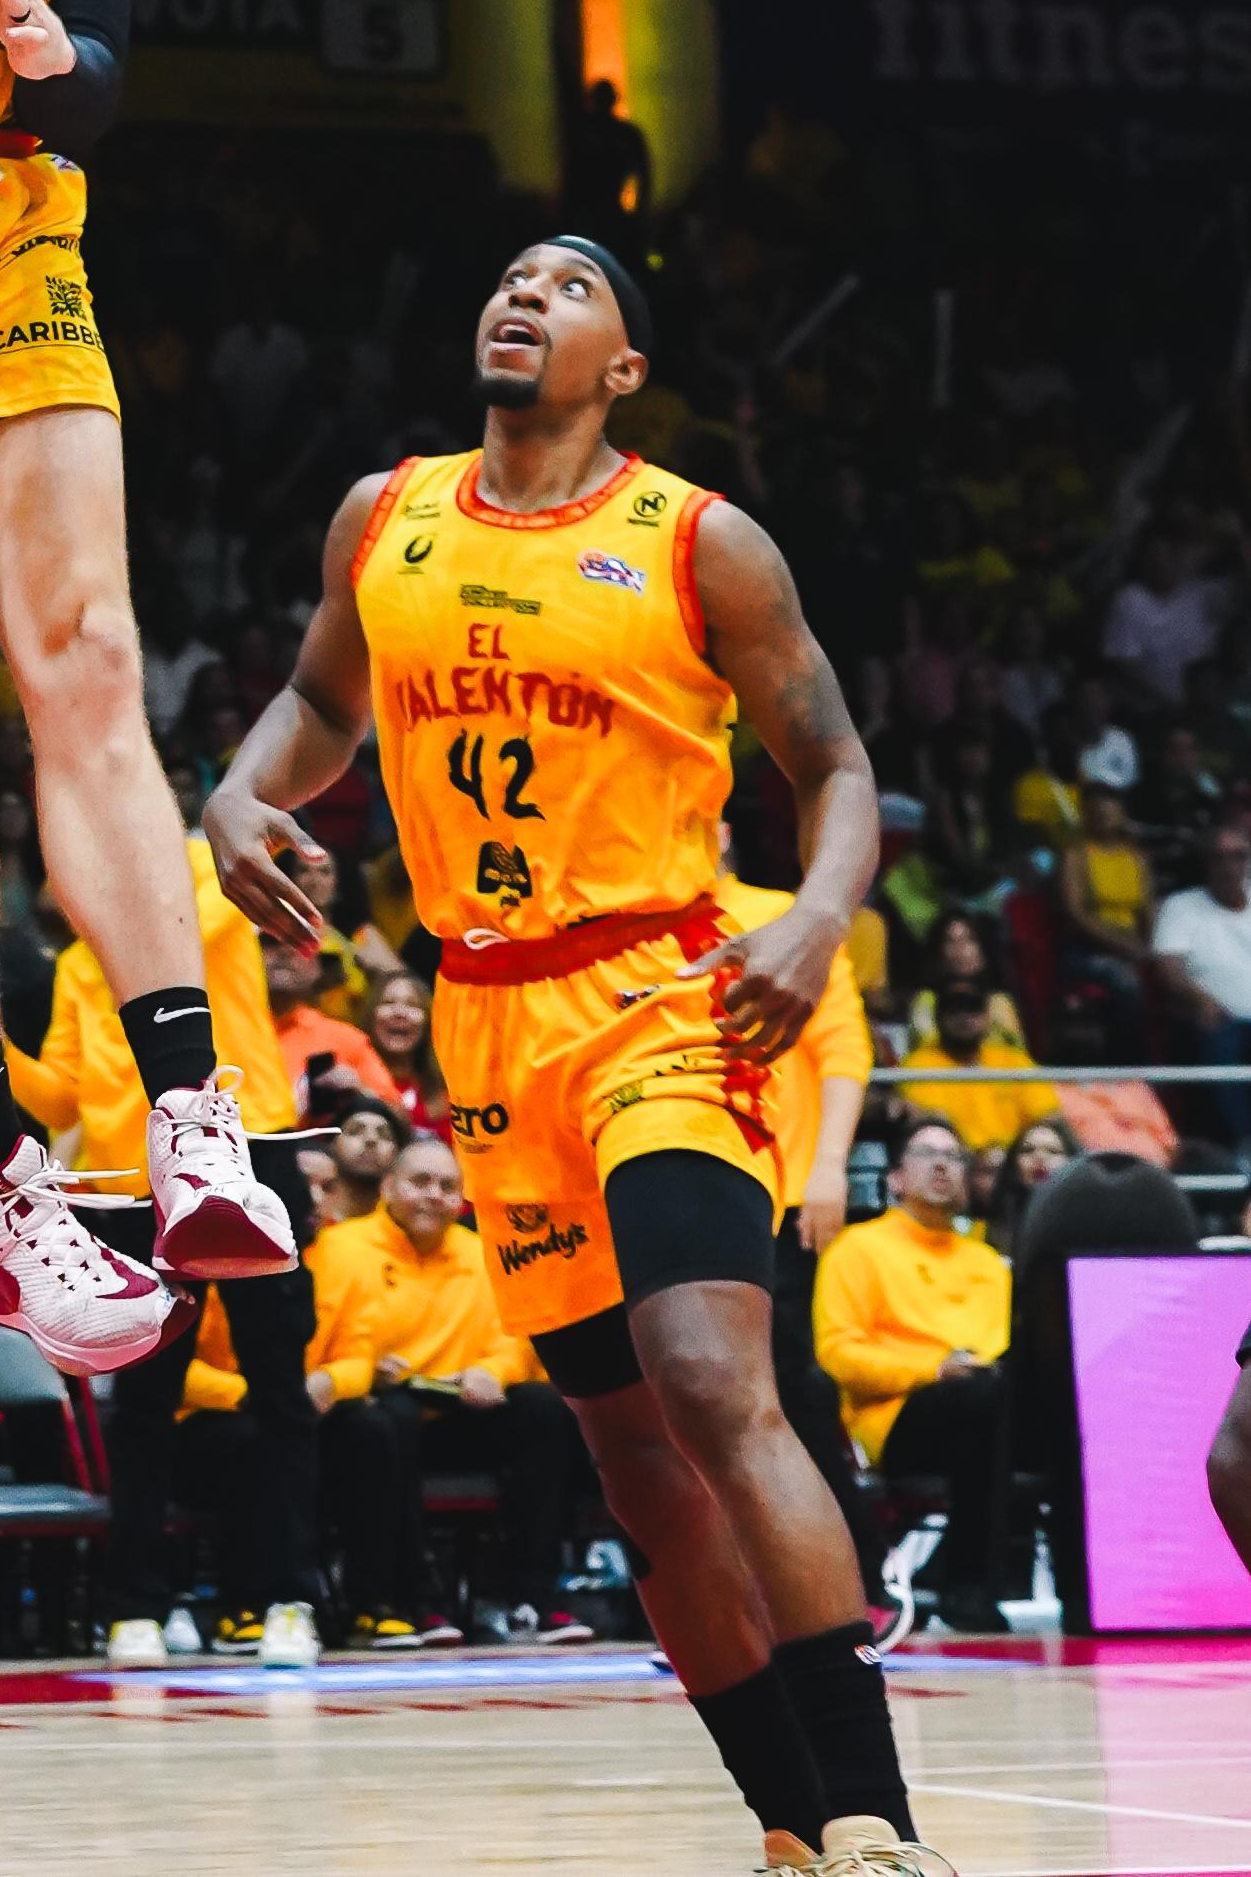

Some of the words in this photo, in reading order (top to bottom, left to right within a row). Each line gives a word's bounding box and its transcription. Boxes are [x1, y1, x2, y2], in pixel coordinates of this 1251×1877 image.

[467, 622, 511, 661] EL
[397, 666, 615, 739] ALENTÓN
[447, 728, 547, 822] 42
